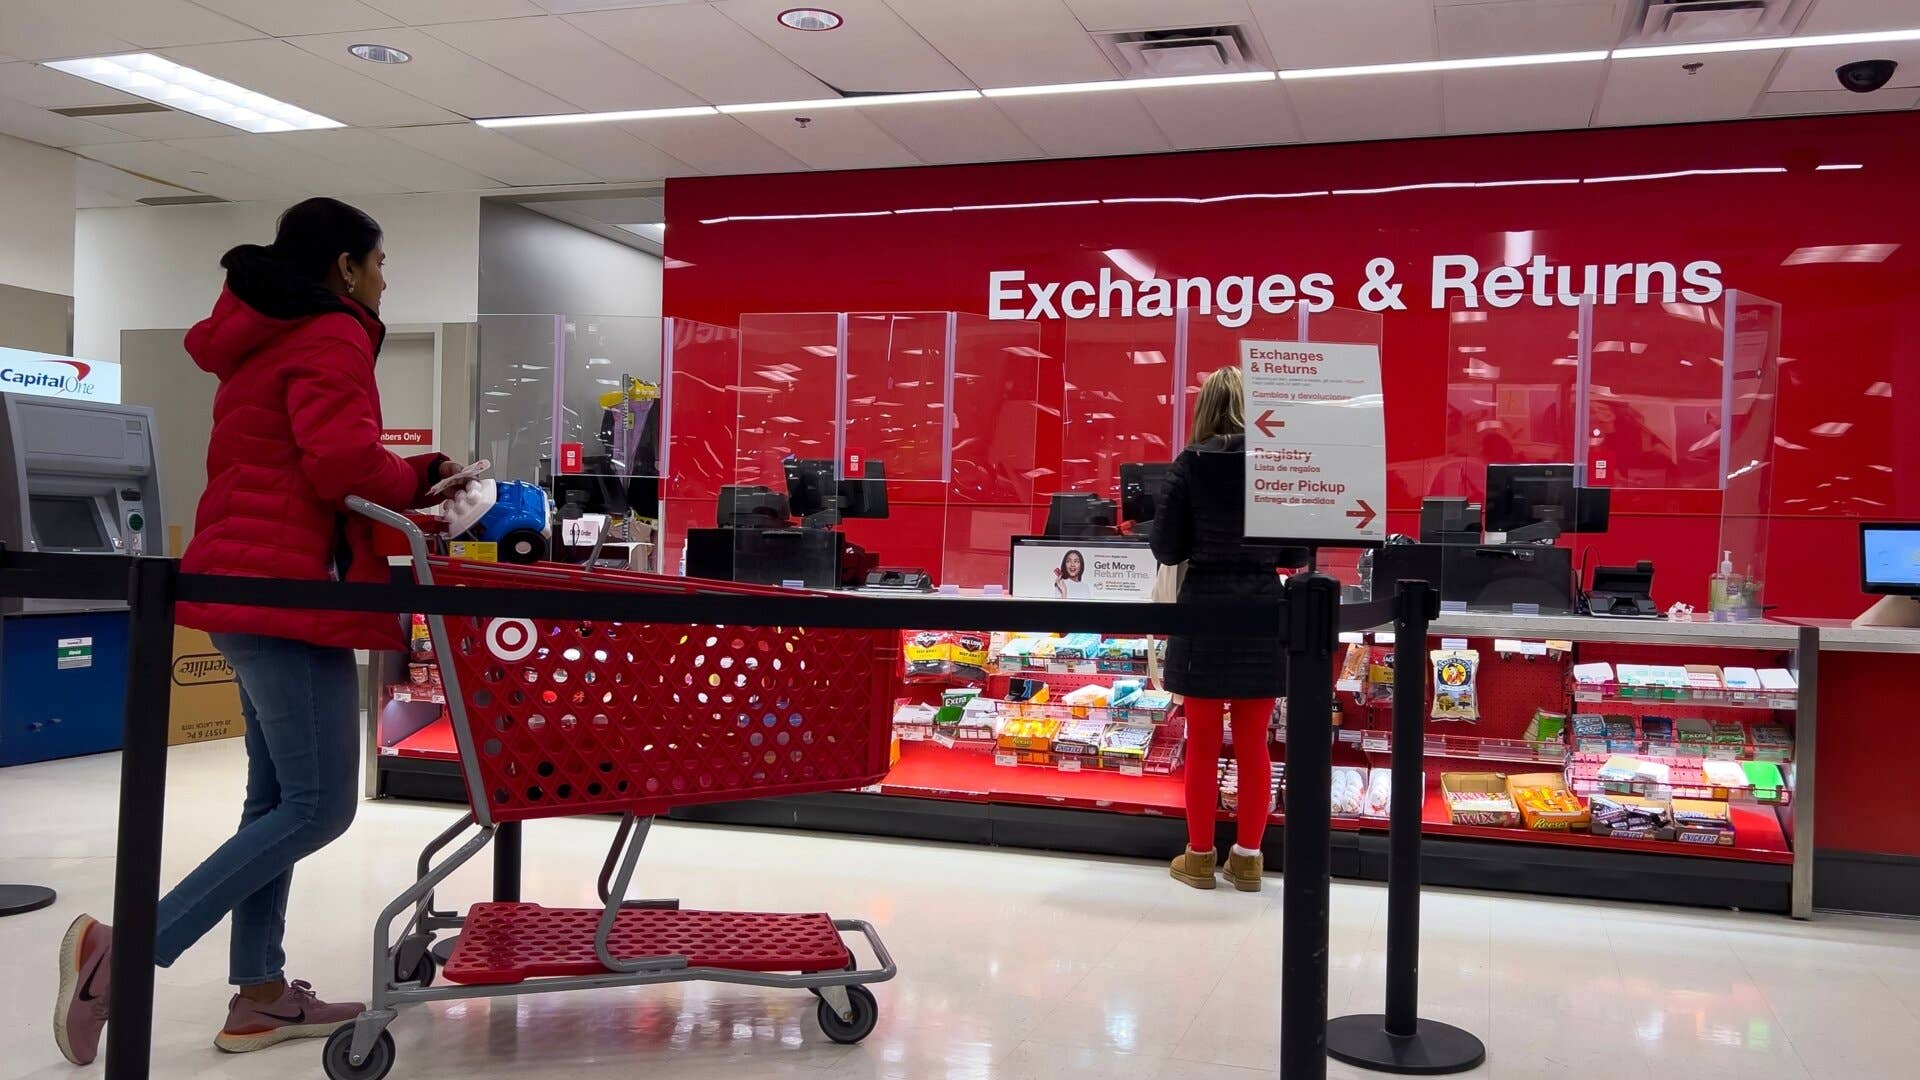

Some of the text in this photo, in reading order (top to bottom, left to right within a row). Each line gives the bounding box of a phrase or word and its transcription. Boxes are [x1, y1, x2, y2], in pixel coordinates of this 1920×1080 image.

[988, 254, 1723, 328] Exchanges & Returns
[1250, 348, 1324, 363] Exchanges
[1250, 362, 1318, 375] & Returns
[1252, 390, 1289, 400] Cambios
[403, 432, 422, 442] Only
[1254, 447, 1312, 463] Registry
[1254, 463, 1321, 474] Lista de regalos
[1254, 478, 1346, 495] Order Pickup
[1254, 495, 1288, 505] Entrega
[1289, 496, 1299, 504] de
[1094, 560, 1136, 571] Get More
[1094, 569, 1124, 578] Return
[1680, 832, 1720, 844] SNICKERS
